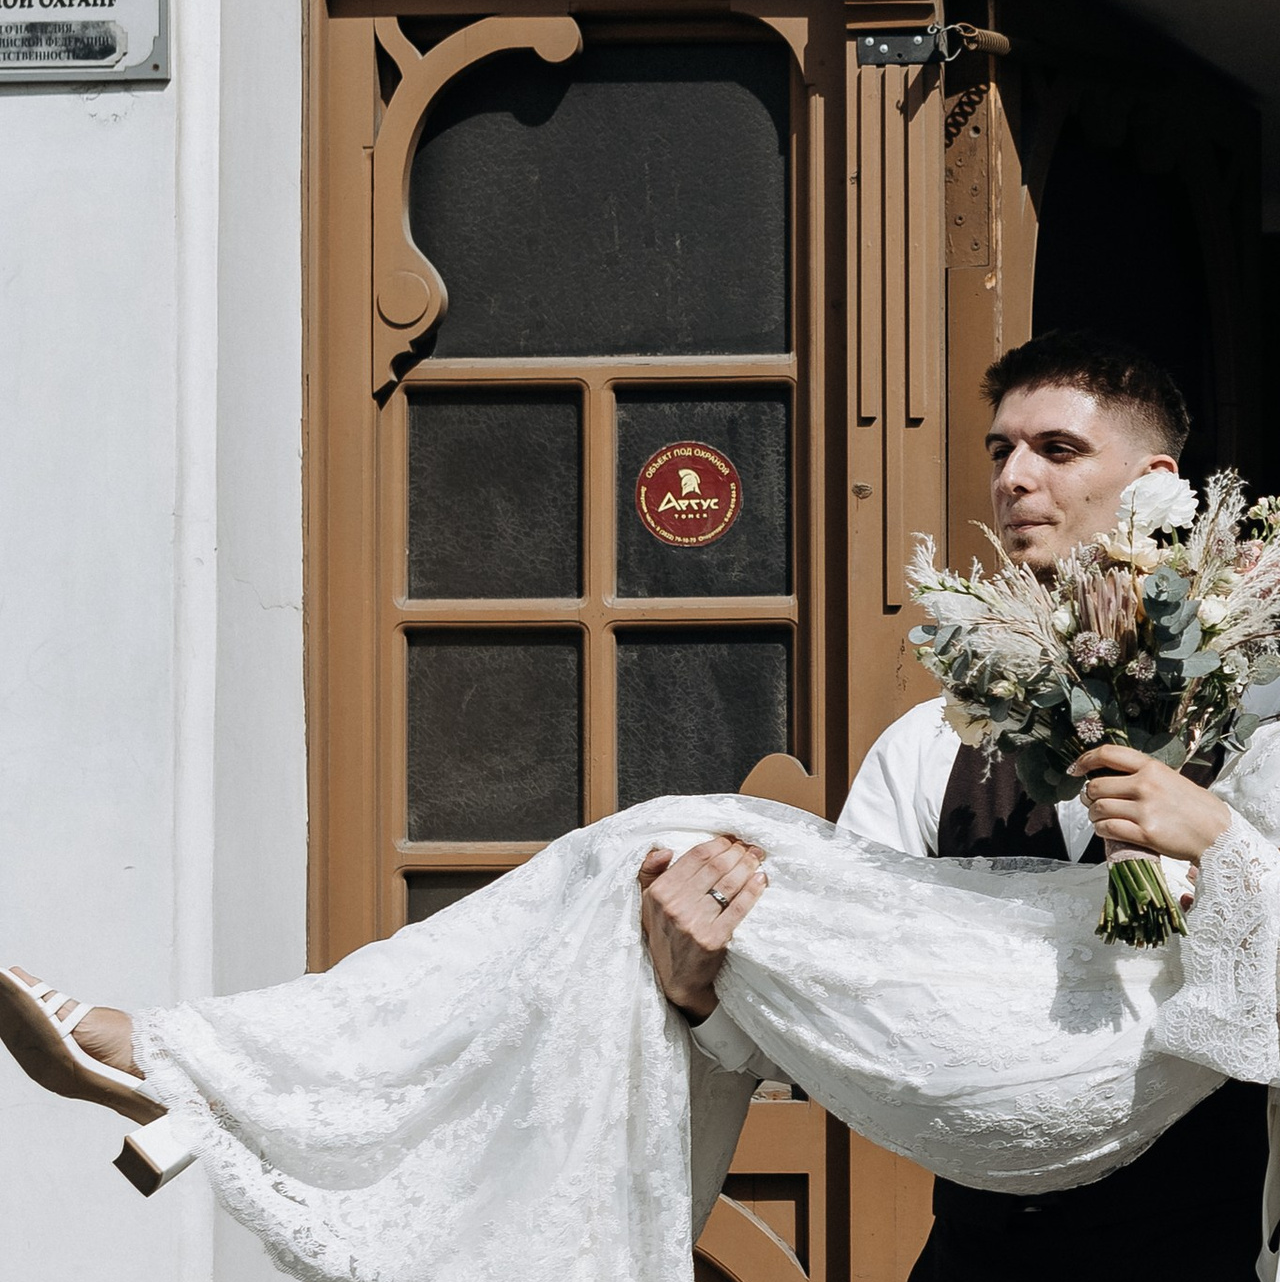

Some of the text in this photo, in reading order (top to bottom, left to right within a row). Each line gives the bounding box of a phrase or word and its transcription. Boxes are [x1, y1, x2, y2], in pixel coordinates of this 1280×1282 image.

[645, 447, 730, 479] ОБЪЕКТ ПОД ОХРАНОЙ
